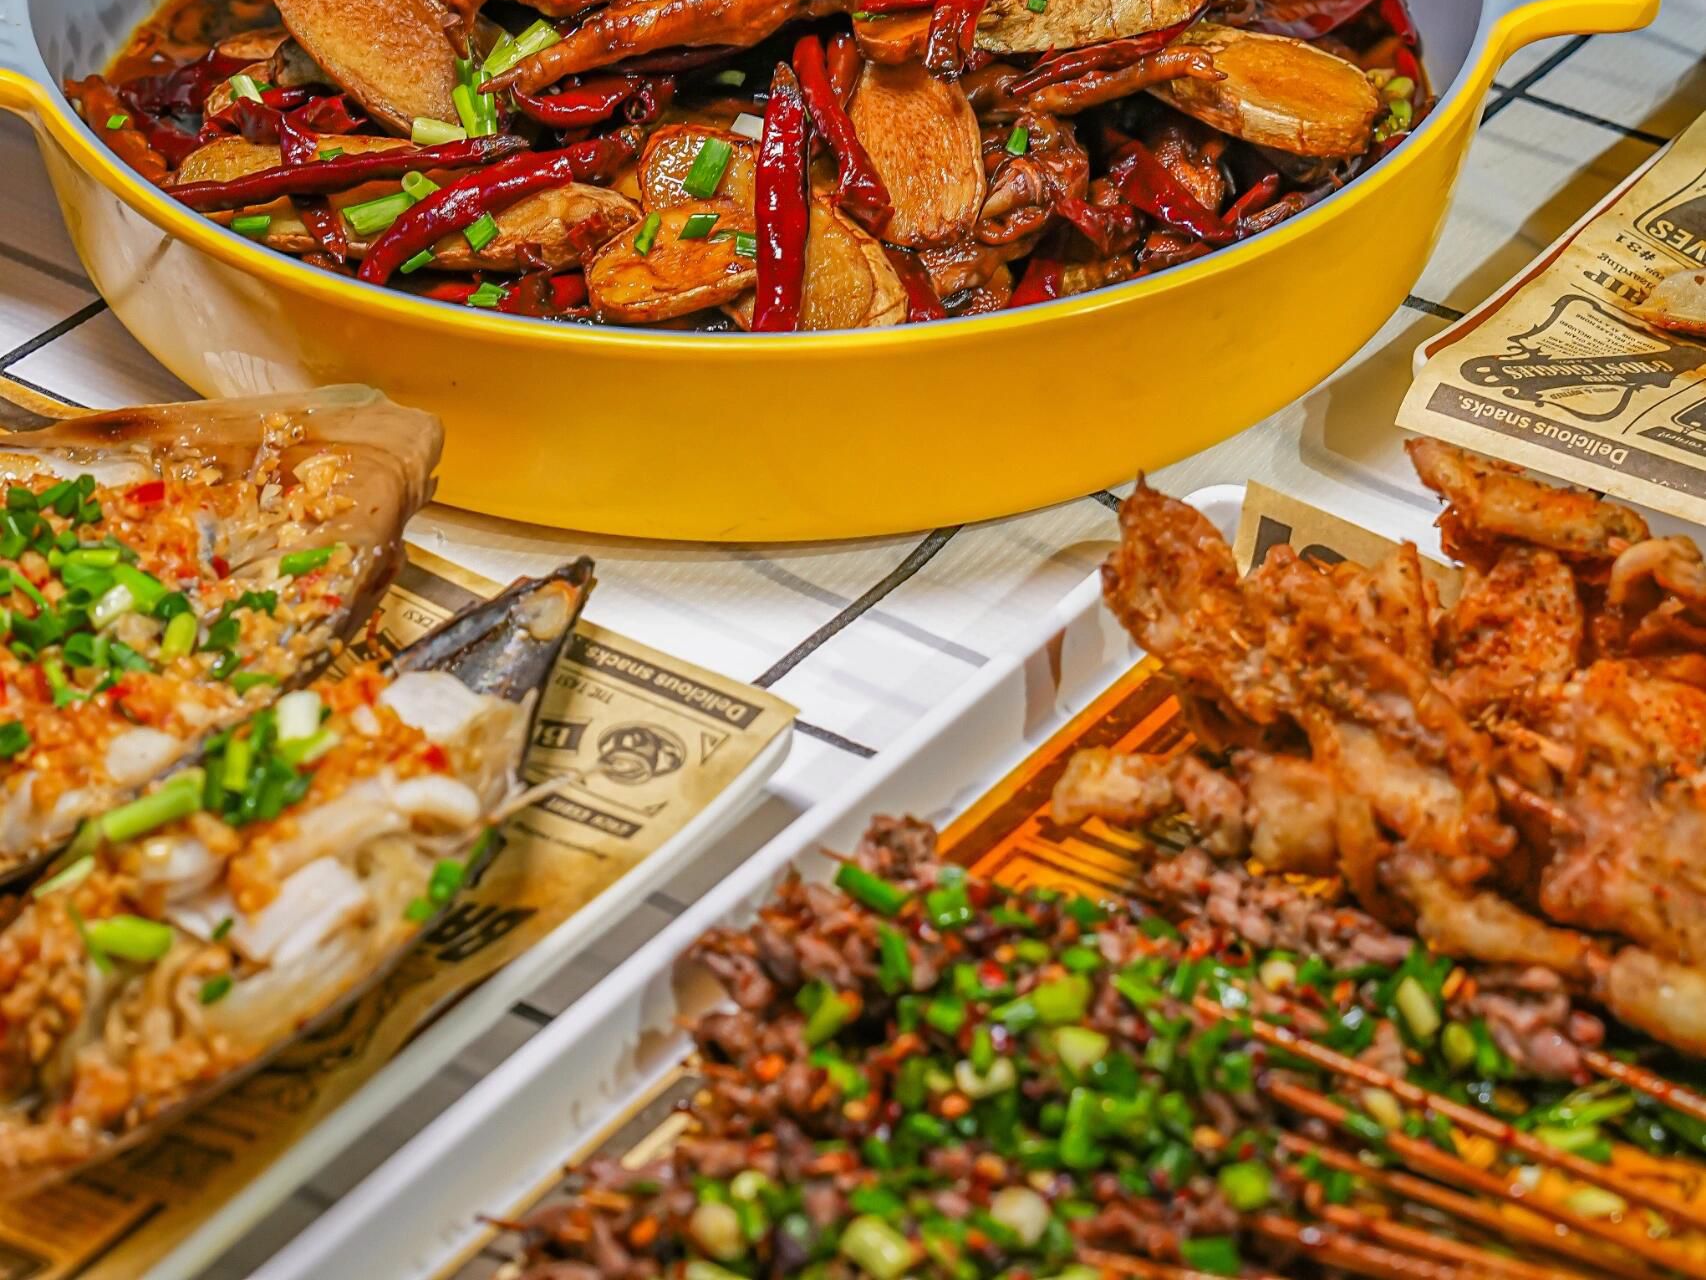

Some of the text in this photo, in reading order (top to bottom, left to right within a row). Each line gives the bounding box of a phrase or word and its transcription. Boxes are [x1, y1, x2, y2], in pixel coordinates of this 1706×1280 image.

[1615, 232, 1656, 262] #31
[1597, 252, 1656, 290] izarding
[1502, 359, 1674, 380] GHOST GIGGLES
[1458, 395, 1629, 465] Delicious snacks.
[653, 673, 748, 721] Delicious
